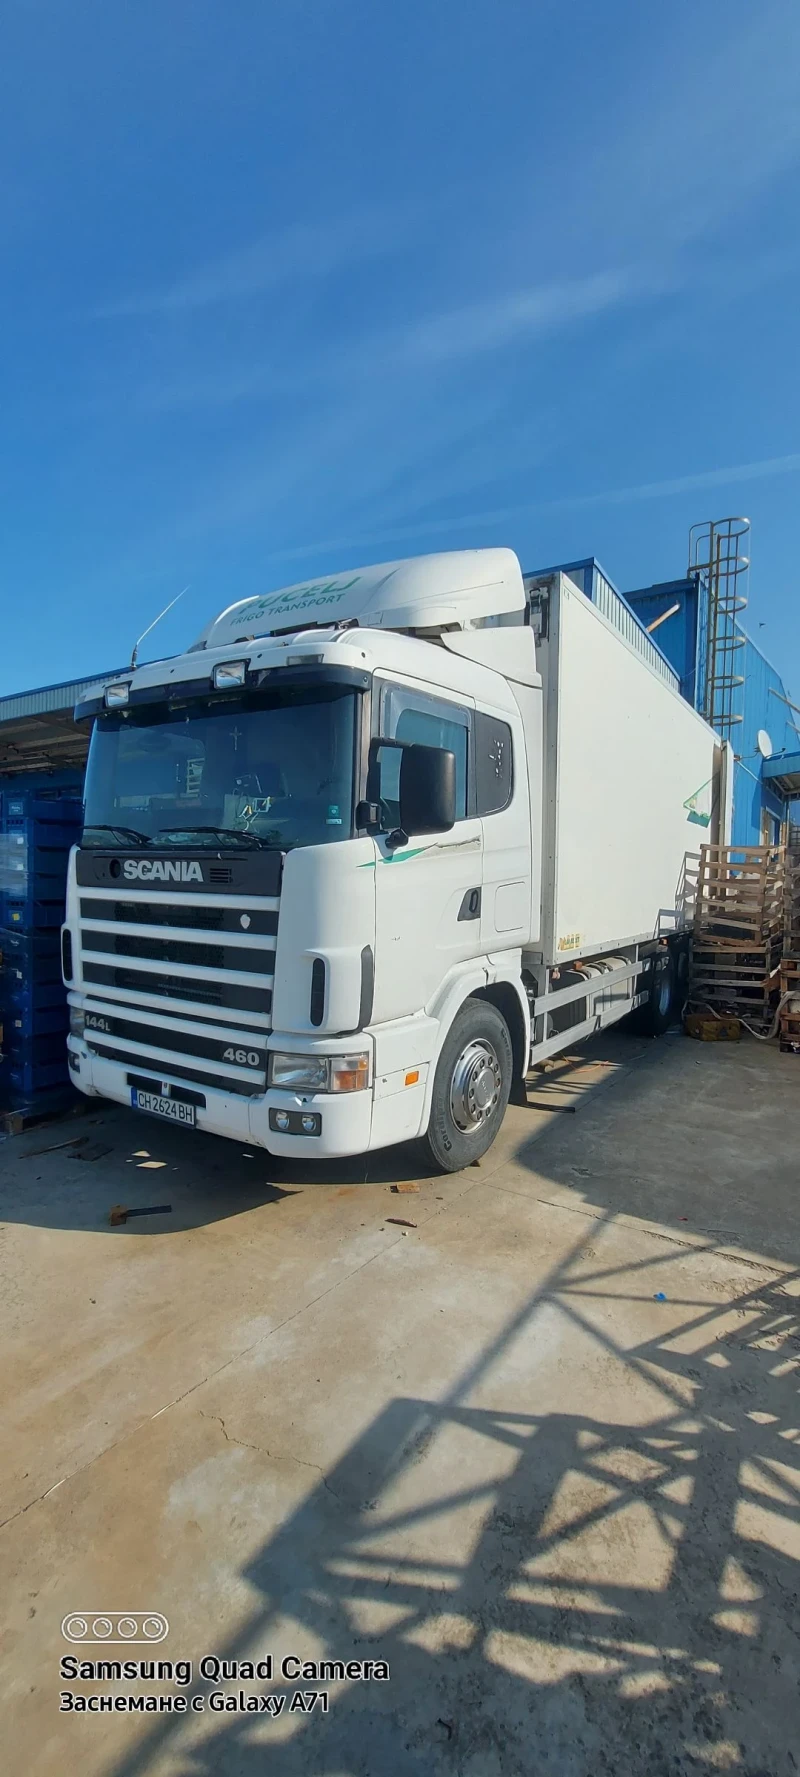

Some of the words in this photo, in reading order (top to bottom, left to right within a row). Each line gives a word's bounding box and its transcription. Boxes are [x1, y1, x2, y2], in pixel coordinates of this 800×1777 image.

[230, 611, 264, 625] FRIGO
[268, 594, 344, 616] TRANSPORT
[123, 860, 204, 882] SCANIA
[85, 1015, 111, 1031] 144L
[222, 1048, 260, 1066] 460
